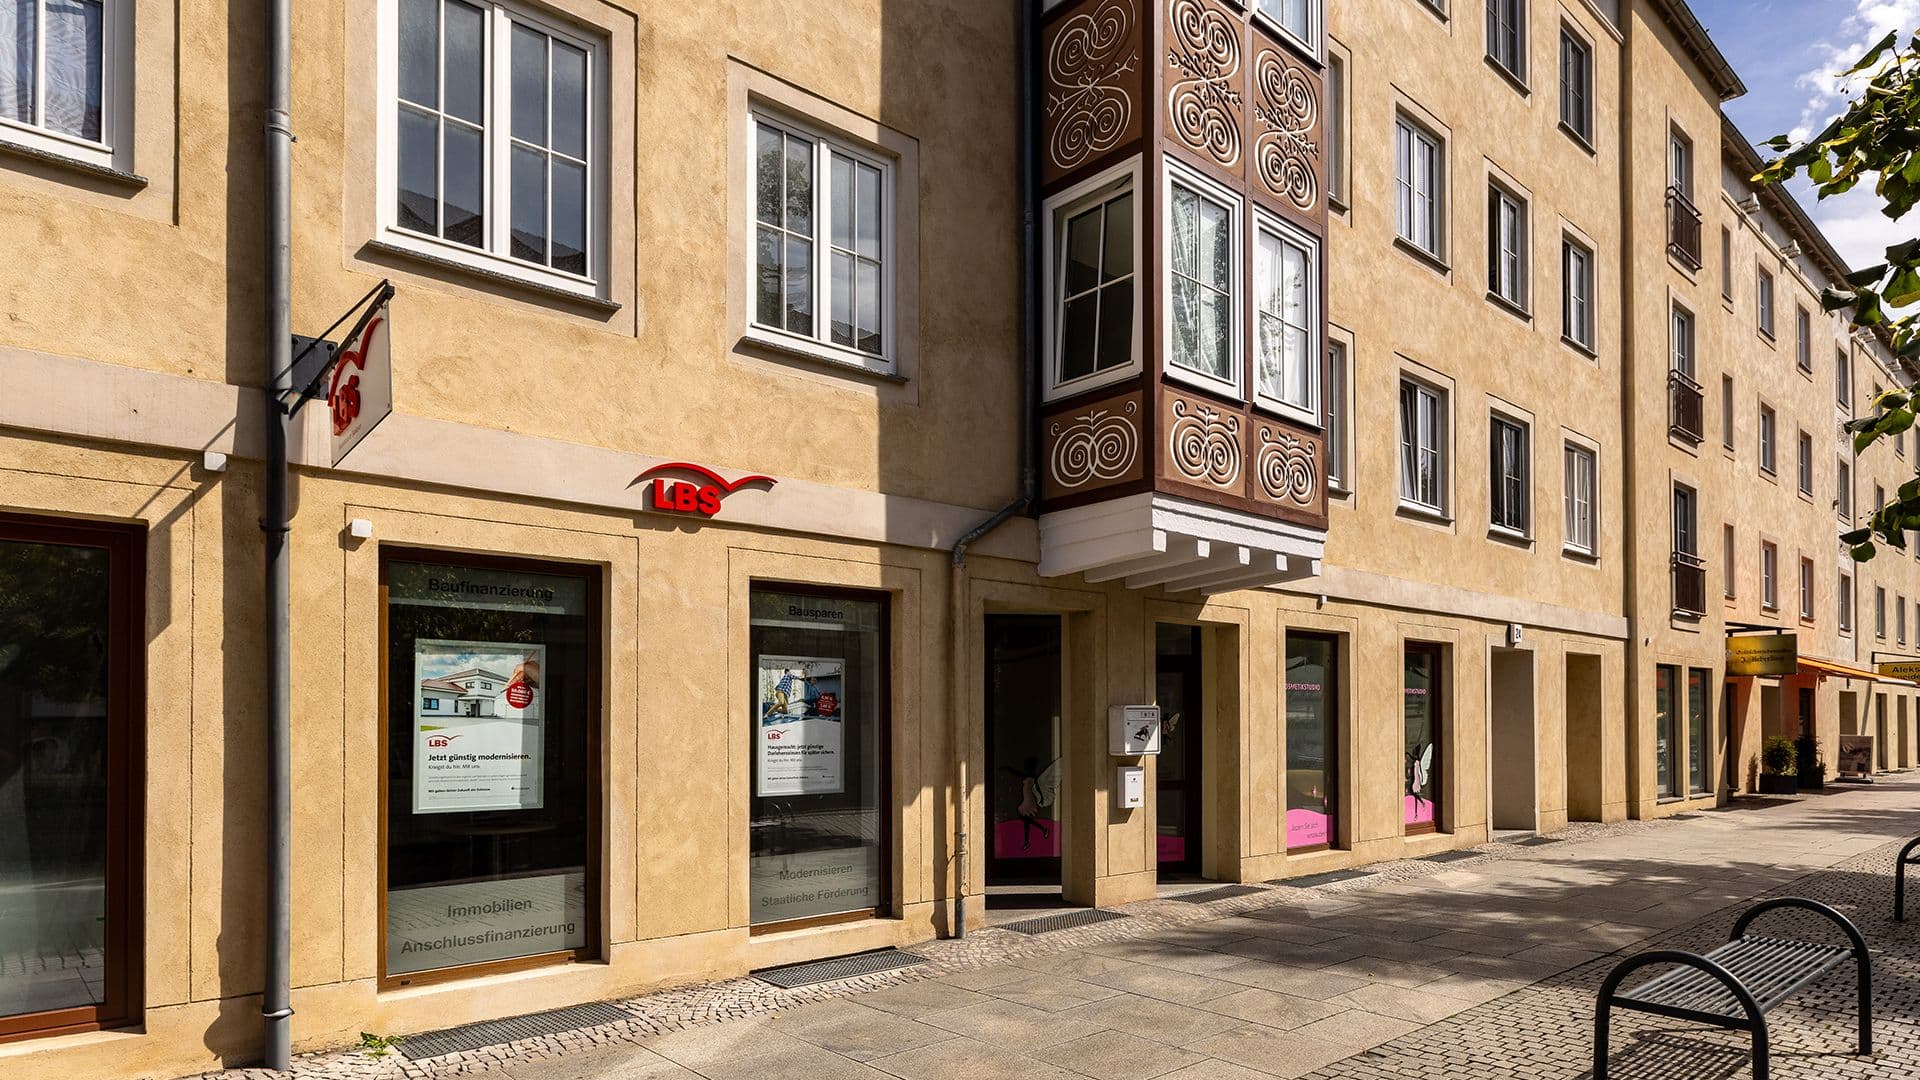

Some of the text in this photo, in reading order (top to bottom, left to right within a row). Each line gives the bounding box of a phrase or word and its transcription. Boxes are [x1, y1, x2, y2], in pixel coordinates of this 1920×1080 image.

[653, 478, 721, 515] LBS
[429, 578, 555, 602] Baufinanzierung
[789, 606, 844, 620] Bausparen
[428, 739, 448, 747] LBS
[428, 752, 531, 763] Jetzt günstig modernisieren.
[779, 865, 853, 880] Modernisieren
[761, 886, 869, 907] Staatliche Förderung
[447, 899, 532, 918] Immobilien
[401, 922, 576, 954] Anschlussfinanzierung
